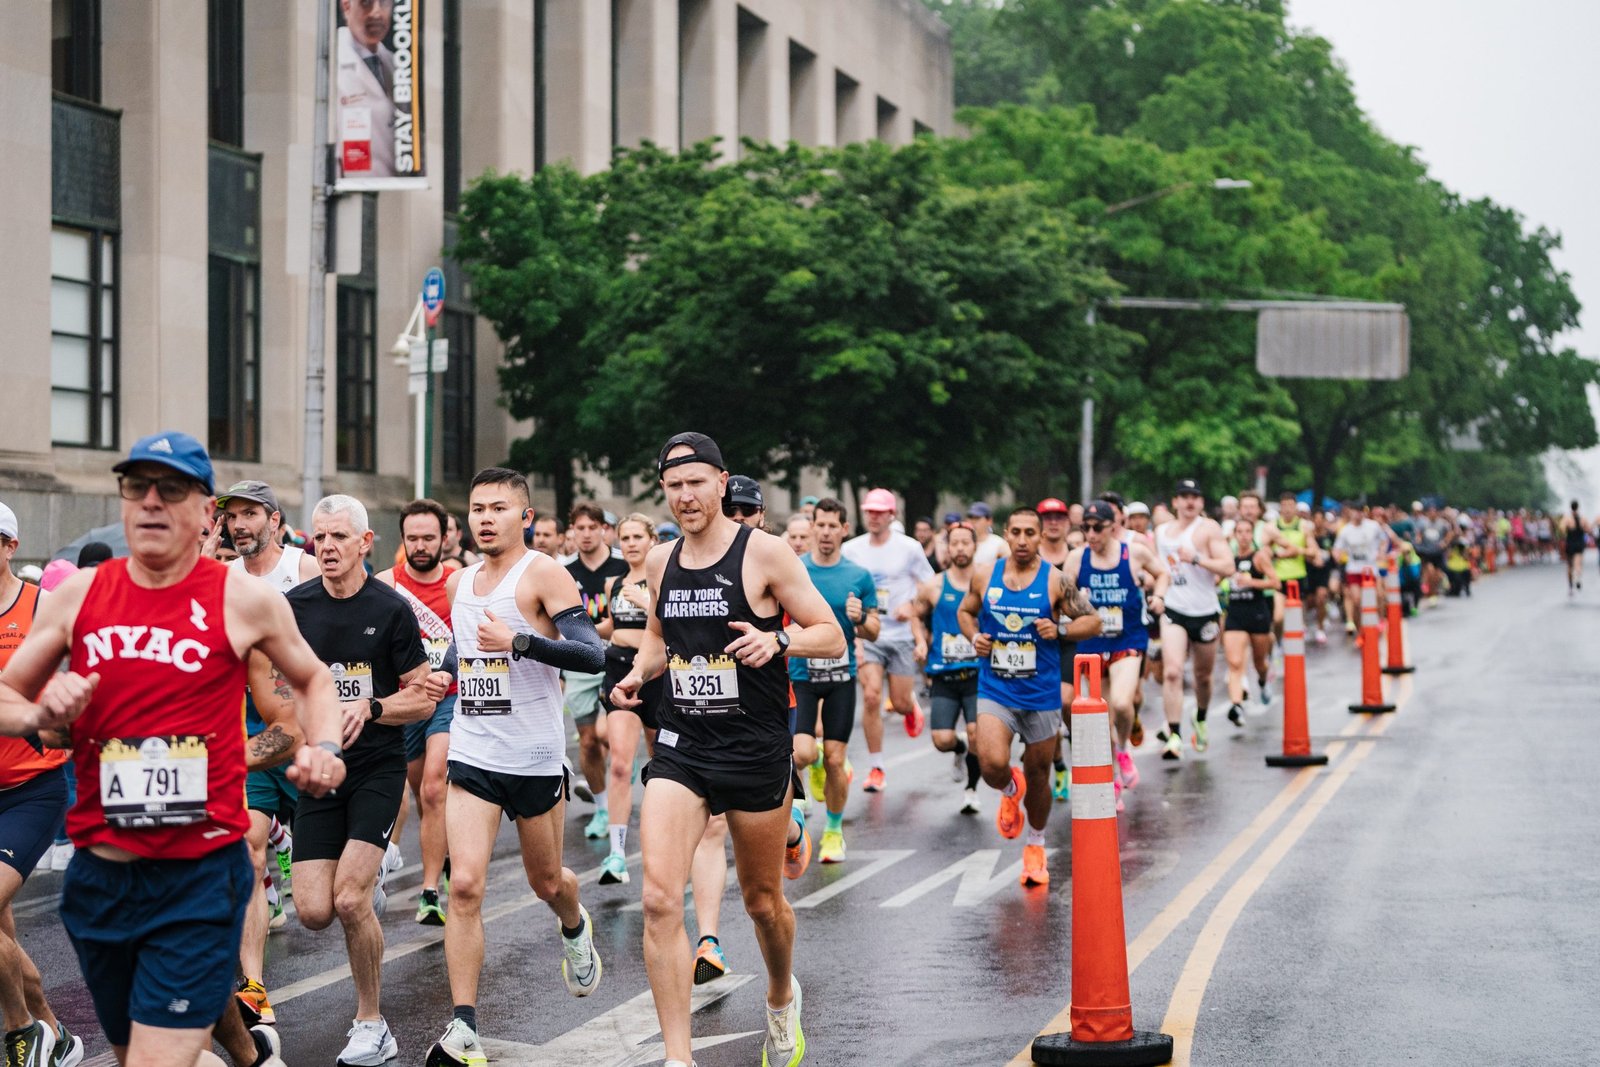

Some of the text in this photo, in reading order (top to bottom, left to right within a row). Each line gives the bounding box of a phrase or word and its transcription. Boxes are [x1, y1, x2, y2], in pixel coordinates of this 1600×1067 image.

[393, 0, 413, 172] STAY BROOKL
[669, 588, 723, 601] NEW YORK
[664, 600, 729, 617] HARRIERS
[83, 625, 210, 673] NYAC
[993, 654, 1025, 667] A 424
[460, 677, 502, 697] B 17891
[675, 675, 724, 696] A 3251
[107, 767, 182, 799] A 791
